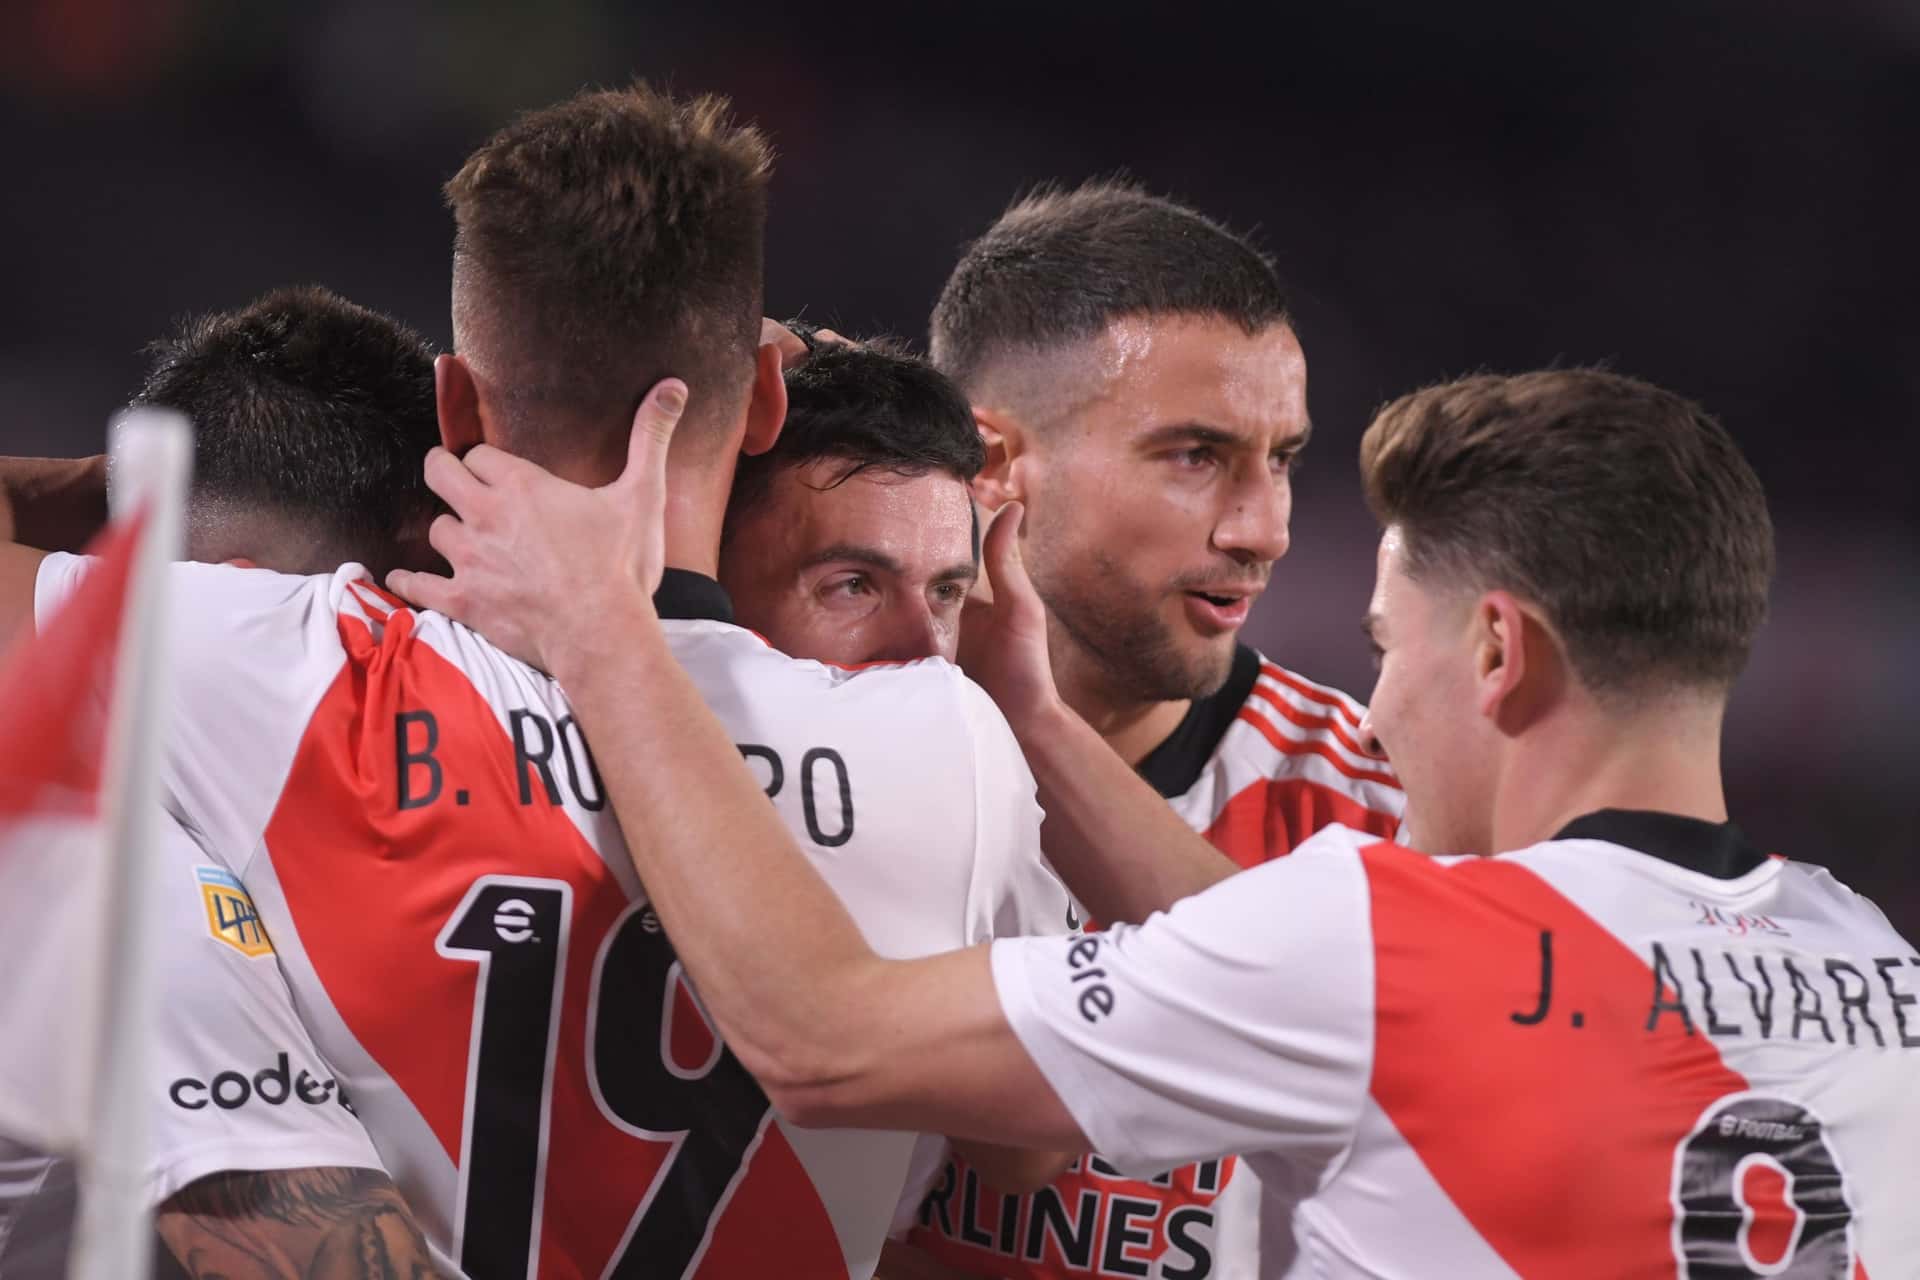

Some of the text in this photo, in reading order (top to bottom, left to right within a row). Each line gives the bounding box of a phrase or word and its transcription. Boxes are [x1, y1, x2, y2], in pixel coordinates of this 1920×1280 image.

[394, 710, 469, 811] B.
[1067, 935, 1115, 1023] ere
[1510, 930, 1920, 1048] J. ALVARE
[168, 1051, 360, 1119] code
[435, 874, 776, 1280] 19
[919, 1160, 1215, 1280] RLINES
